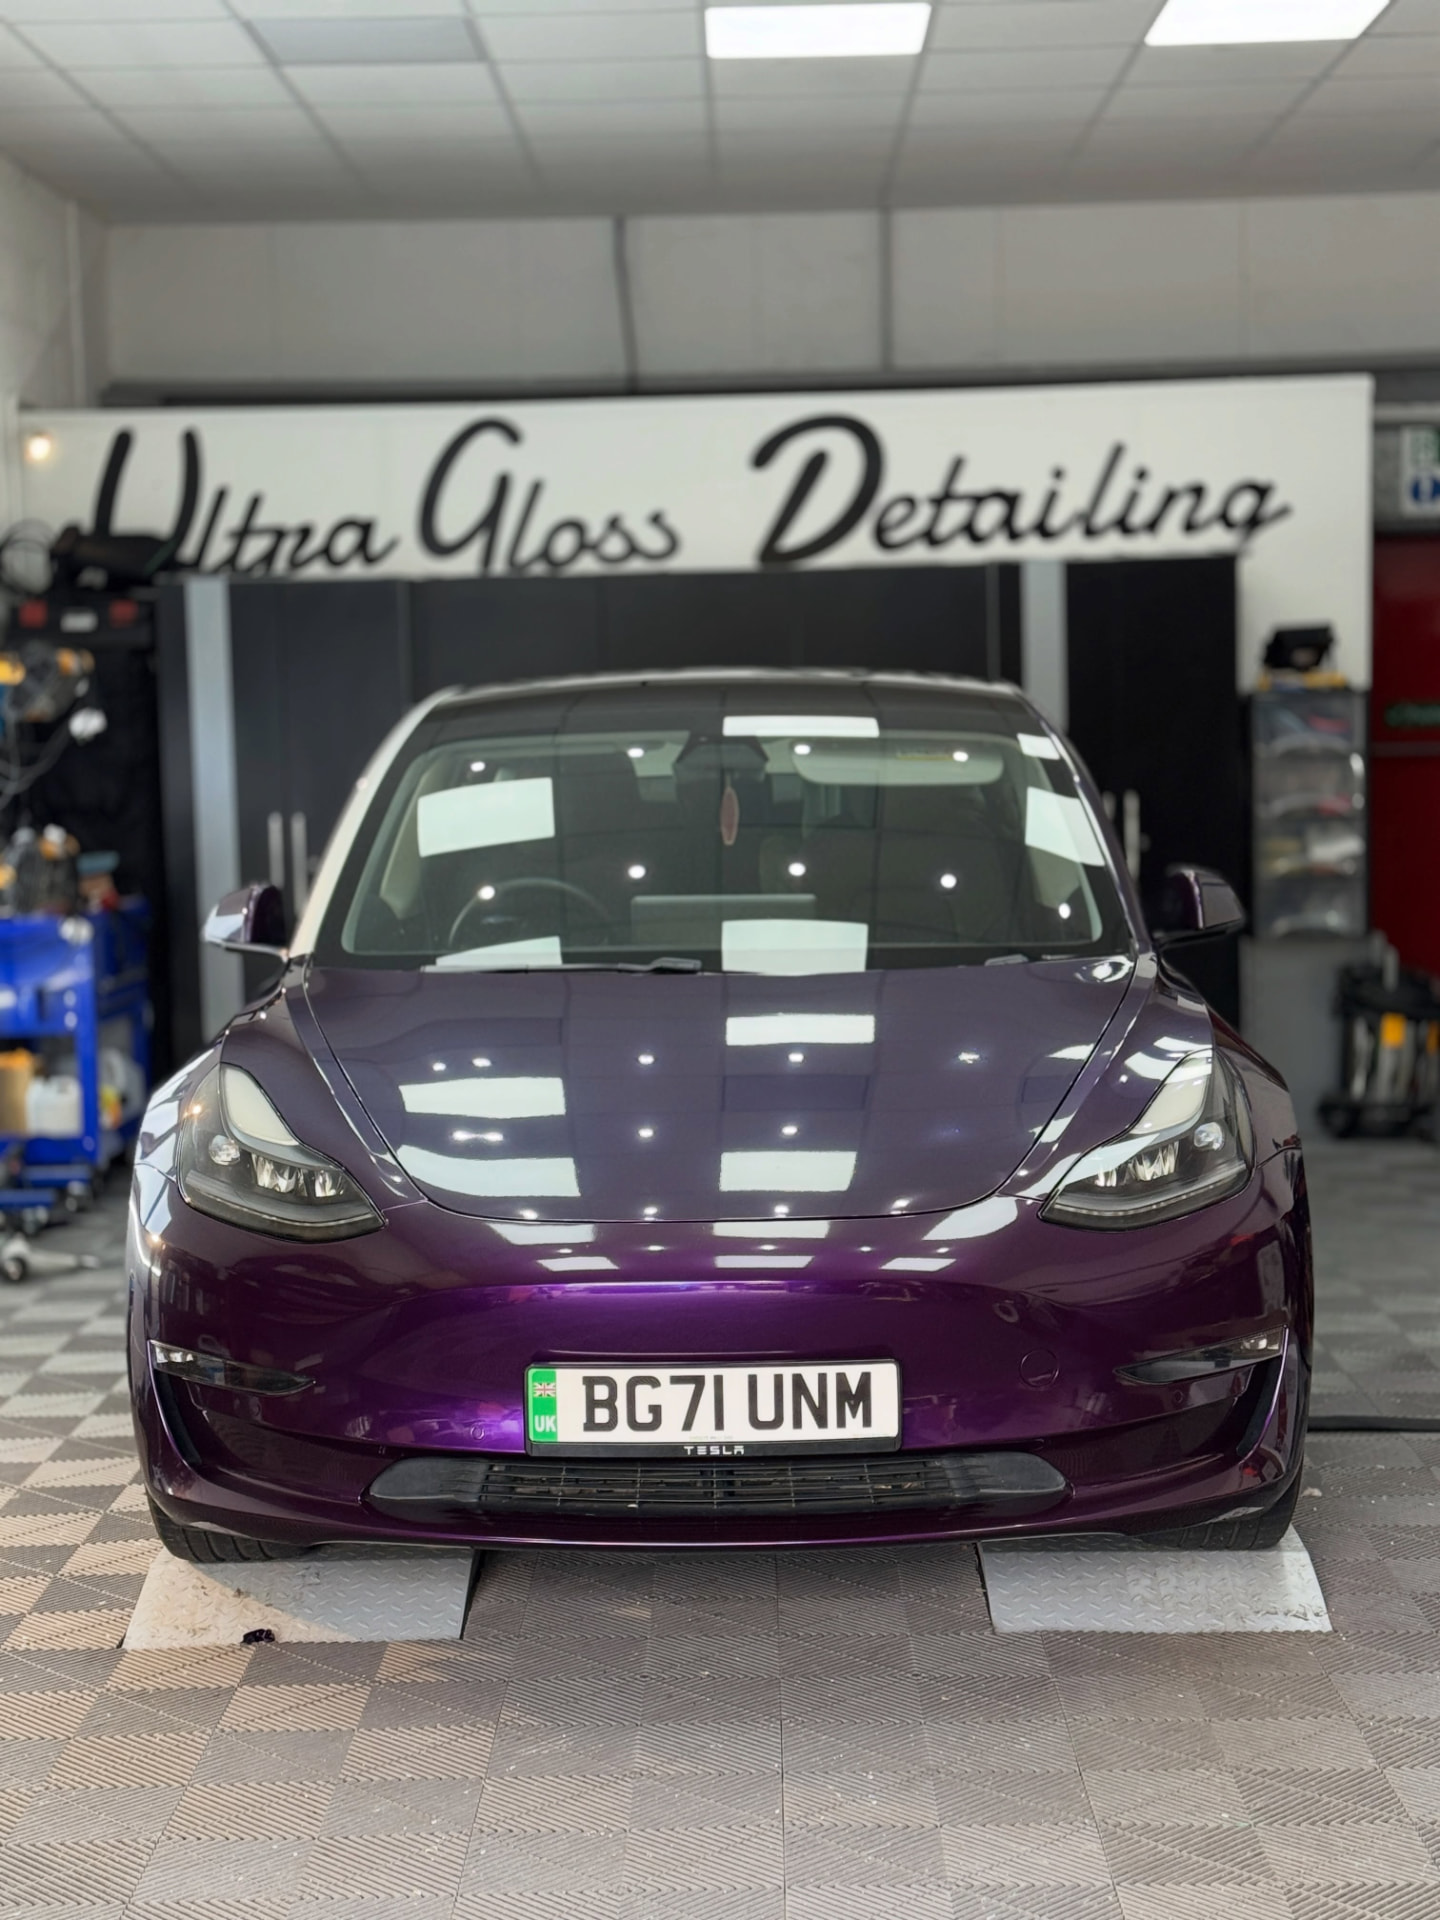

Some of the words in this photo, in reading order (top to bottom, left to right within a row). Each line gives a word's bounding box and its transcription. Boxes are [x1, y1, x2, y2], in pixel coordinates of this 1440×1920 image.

[93, 426, 401, 575] Ultra
[417, 416, 682, 575] Gloss
[749, 413, 1293, 567] Detailing
[582, 1374, 725, 1432] BG71
[747, 1371, 873, 1431] UNM
[534, 1414, 556, 1433] UK
[683, 1445, 745, 1455] TESLA
